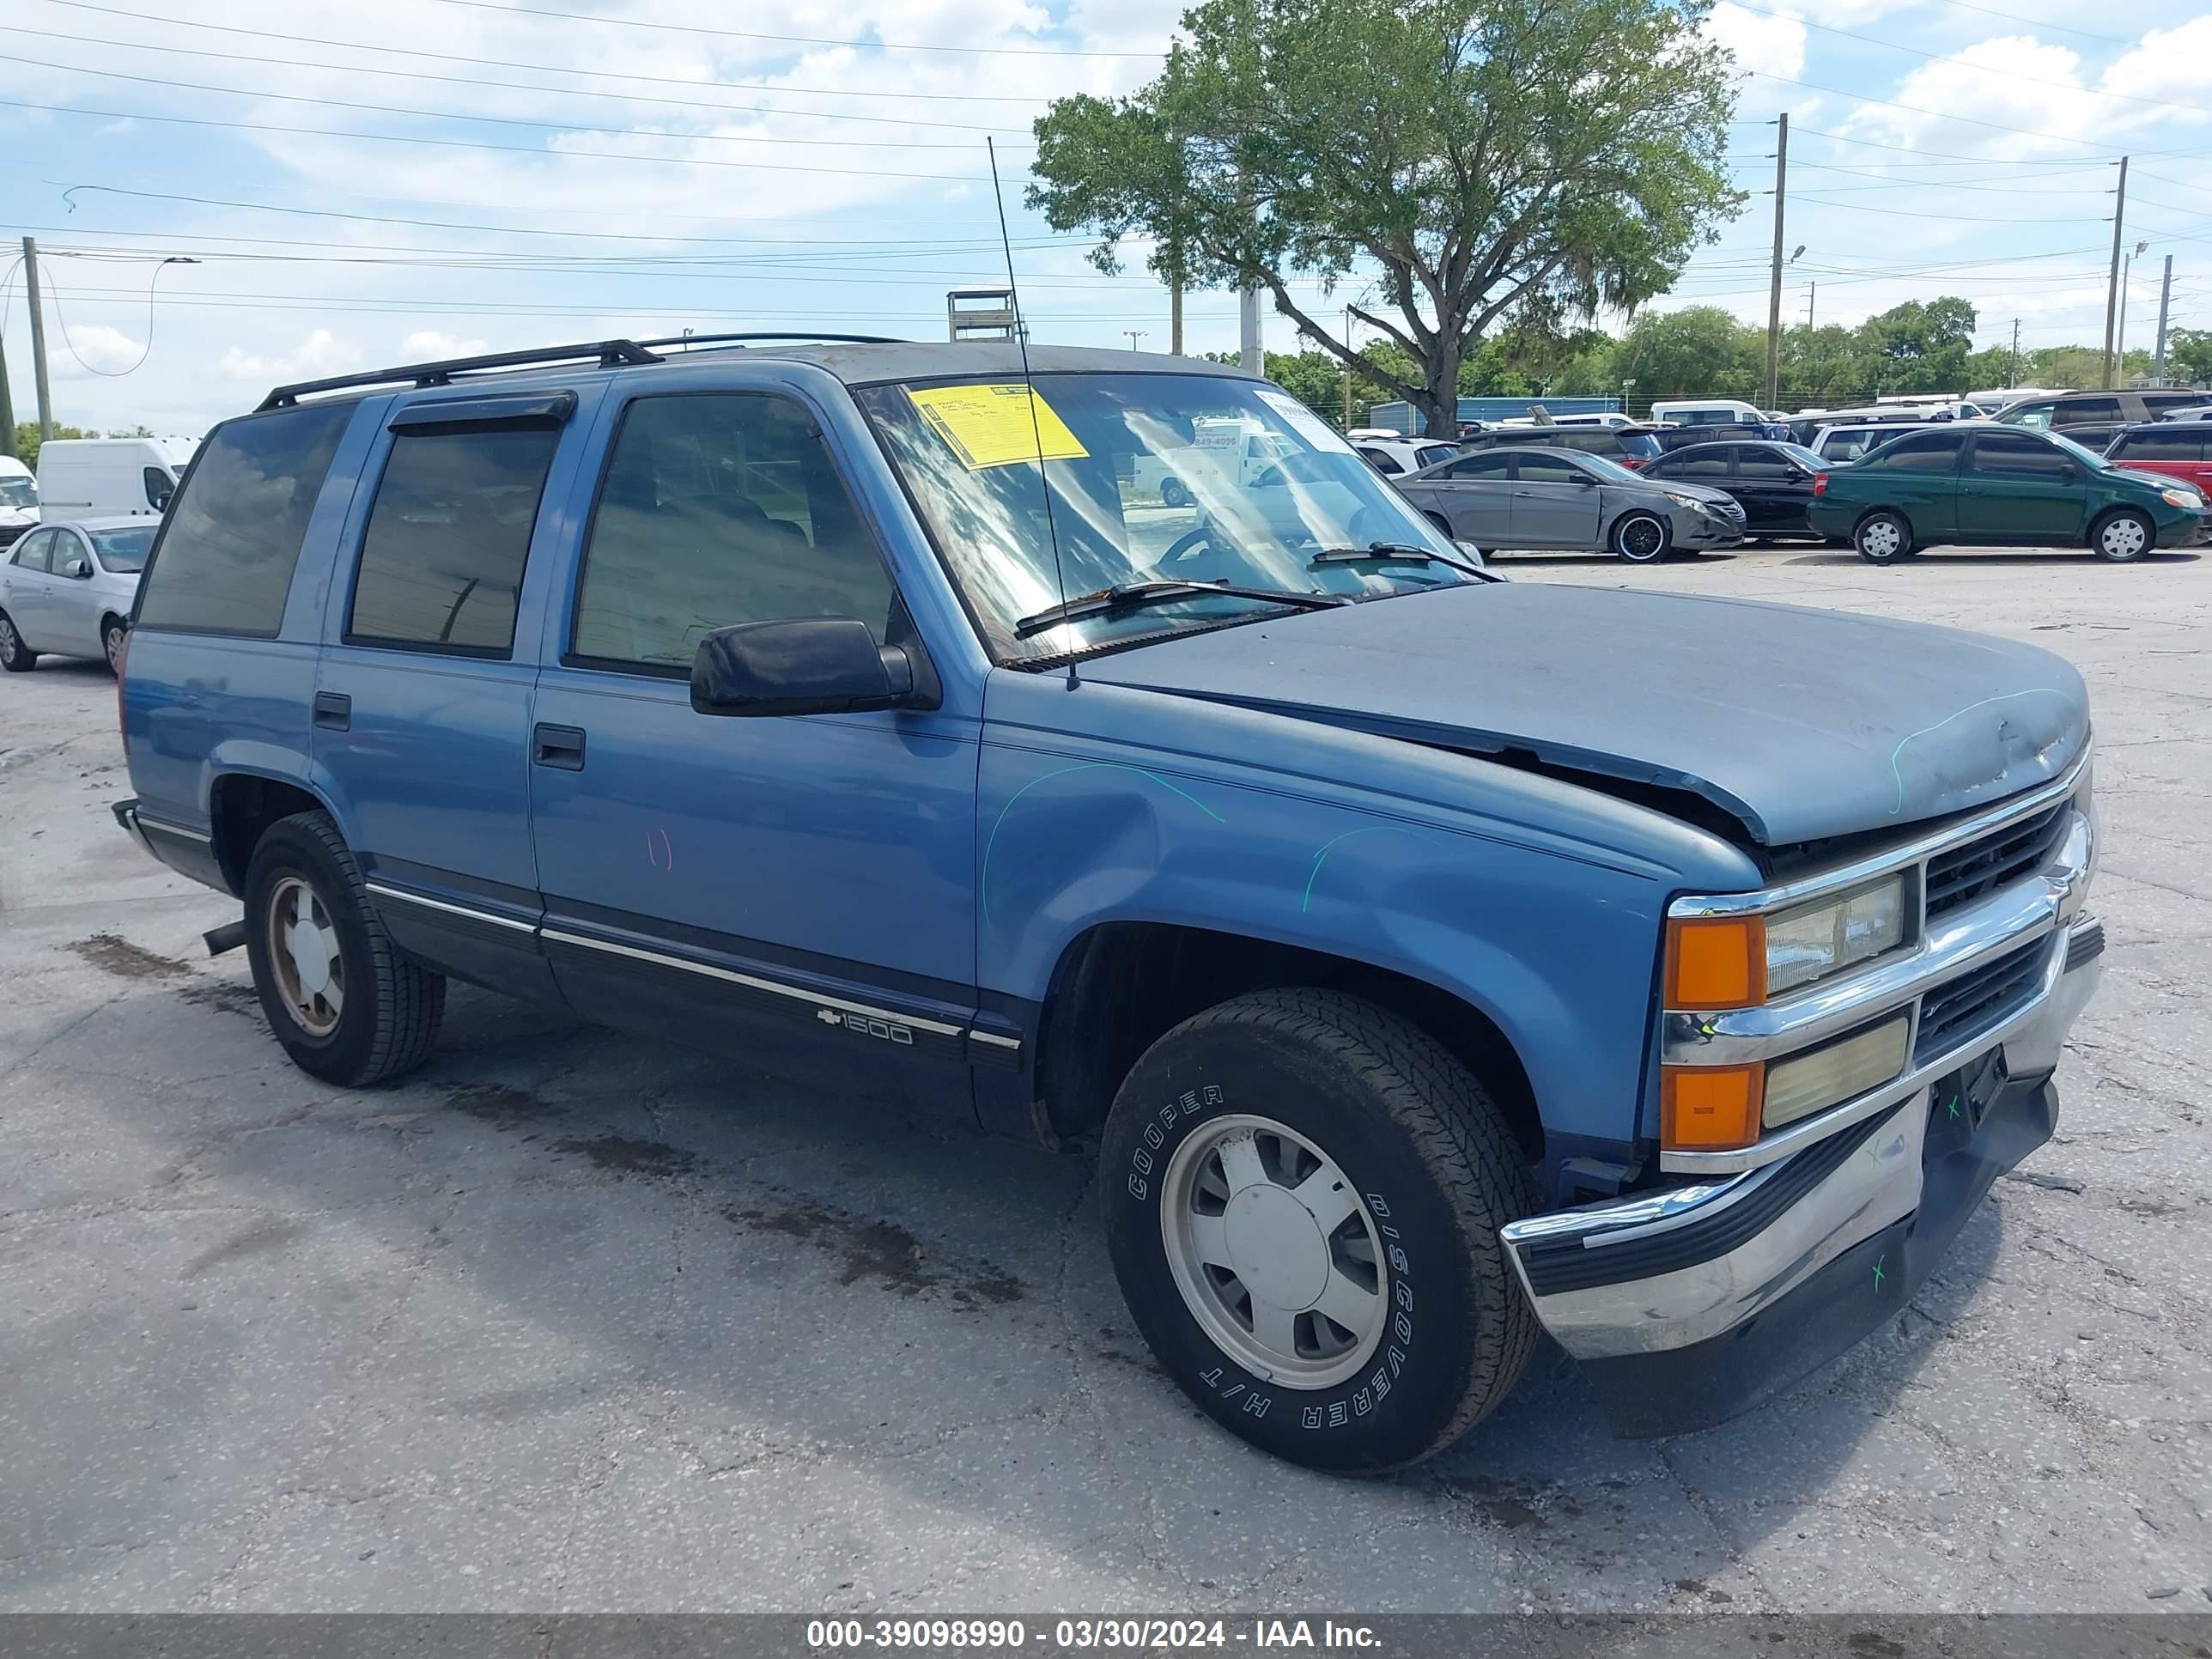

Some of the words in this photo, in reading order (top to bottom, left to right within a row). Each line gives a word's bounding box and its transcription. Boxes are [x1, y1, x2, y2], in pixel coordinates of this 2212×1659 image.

[842, 1013, 913, 1045] 1500
[1128, 1085, 1224, 1200] COOPER
[1302, 1193, 1413, 1429] DISCOVERER
[1199, 1368, 1272, 1419] H/T
